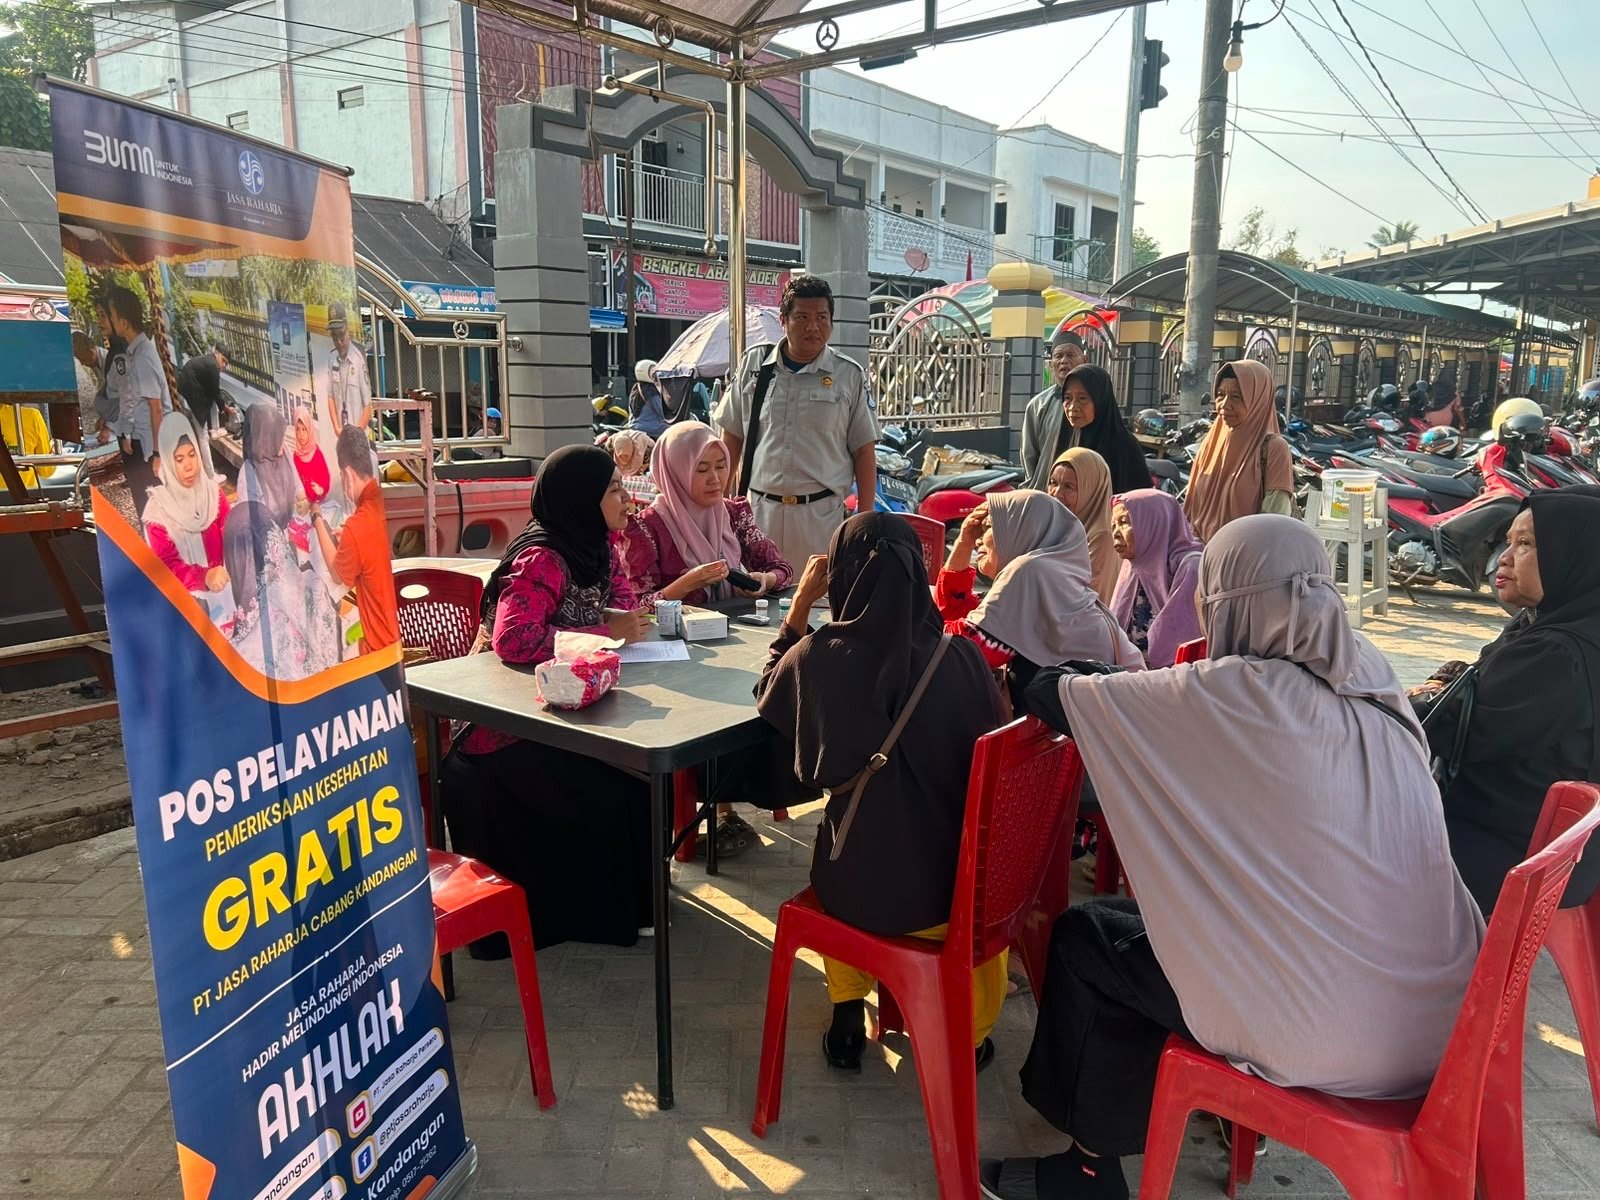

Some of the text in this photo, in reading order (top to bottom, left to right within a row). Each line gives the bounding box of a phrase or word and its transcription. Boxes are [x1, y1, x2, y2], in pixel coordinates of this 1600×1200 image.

[83, 129, 156, 177] BUMN
[155, 159, 180, 173] UNTUK
[156, 171, 193, 187] INDONESIA
[226, 191, 283, 216] JASA RAHARJA
[439, 287, 479, 305] WARUNG
[642, 256, 704, 279] BENGKEL
[158, 689, 405, 842] POS PELAYANAN
[205, 747, 389, 862] PEMERIKSAAN KESEHATAN
[202, 785, 403, 951] GRATIS
[193, 847, 418, 1016] PT JASA RAHARJA CABANG KANDANGAN
[242, 943, 404, 1083] HADIR MELINDUNGI INDONESIA
[285, 955, 366, 1028] JASA RAHARJA
[257, 977, 405, 1160] AKHLAK
[382, 1072, 396, 1089] Jasa
[395, 1052, 418, 1076] Raharja
[418, 1034, 437, 1055] Persero
[380, 1083, 435, 1146] @ptjasaraharja
[367, 1112, 445, 1200] Kandangan
